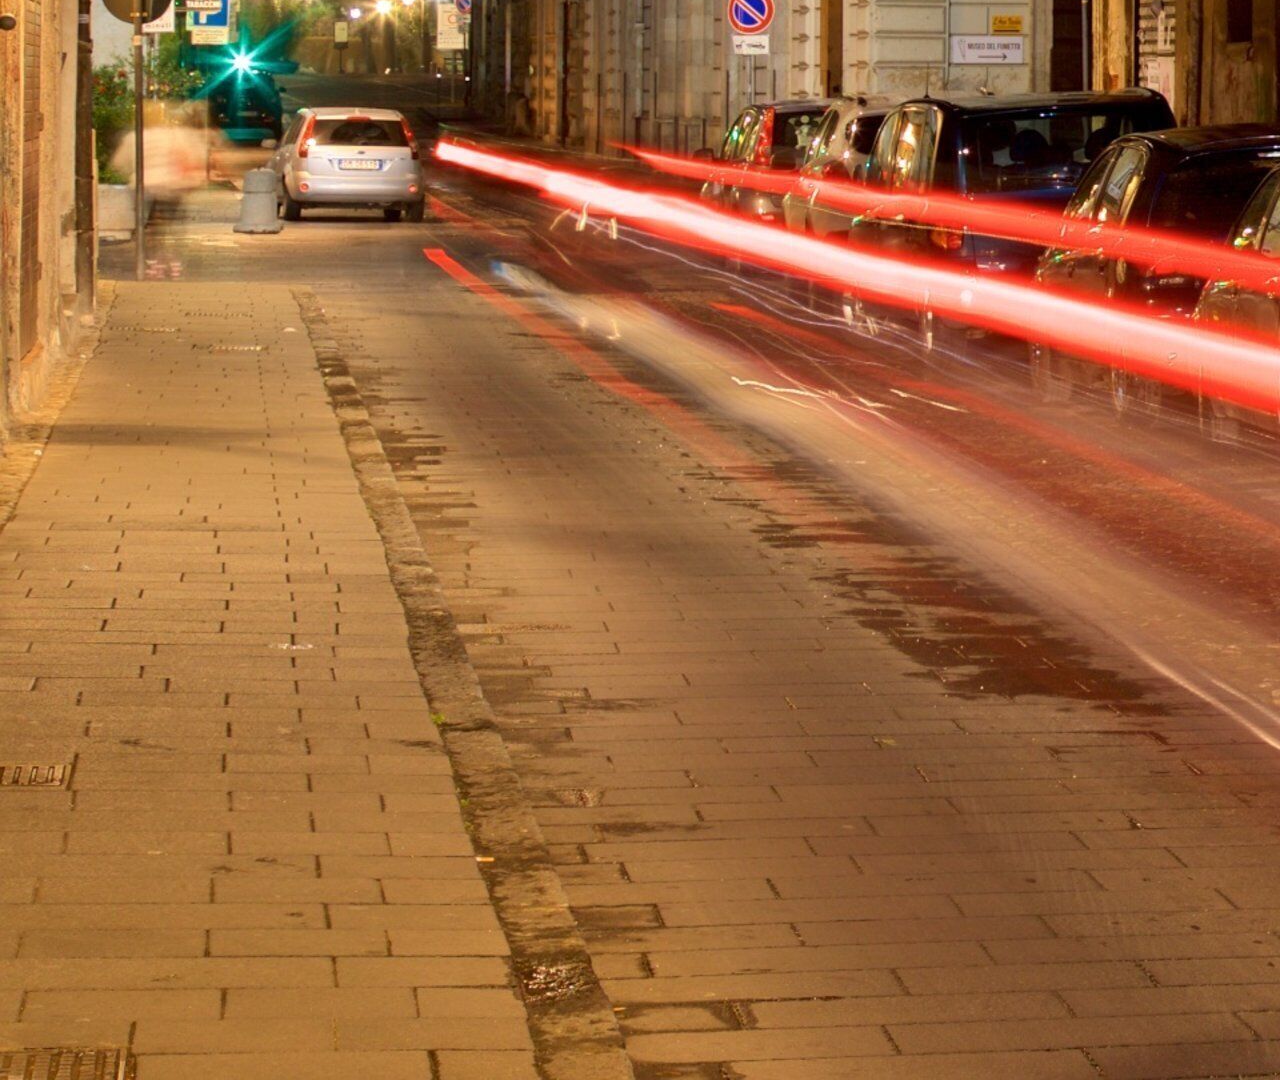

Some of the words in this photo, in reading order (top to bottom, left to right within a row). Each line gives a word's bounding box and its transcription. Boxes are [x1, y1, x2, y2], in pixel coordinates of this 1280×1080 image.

[967, 42, 985, 50] MUSEO
[986, 42, 996, 50] DEL
[997, 42, 1021, 50] FUMETTO
